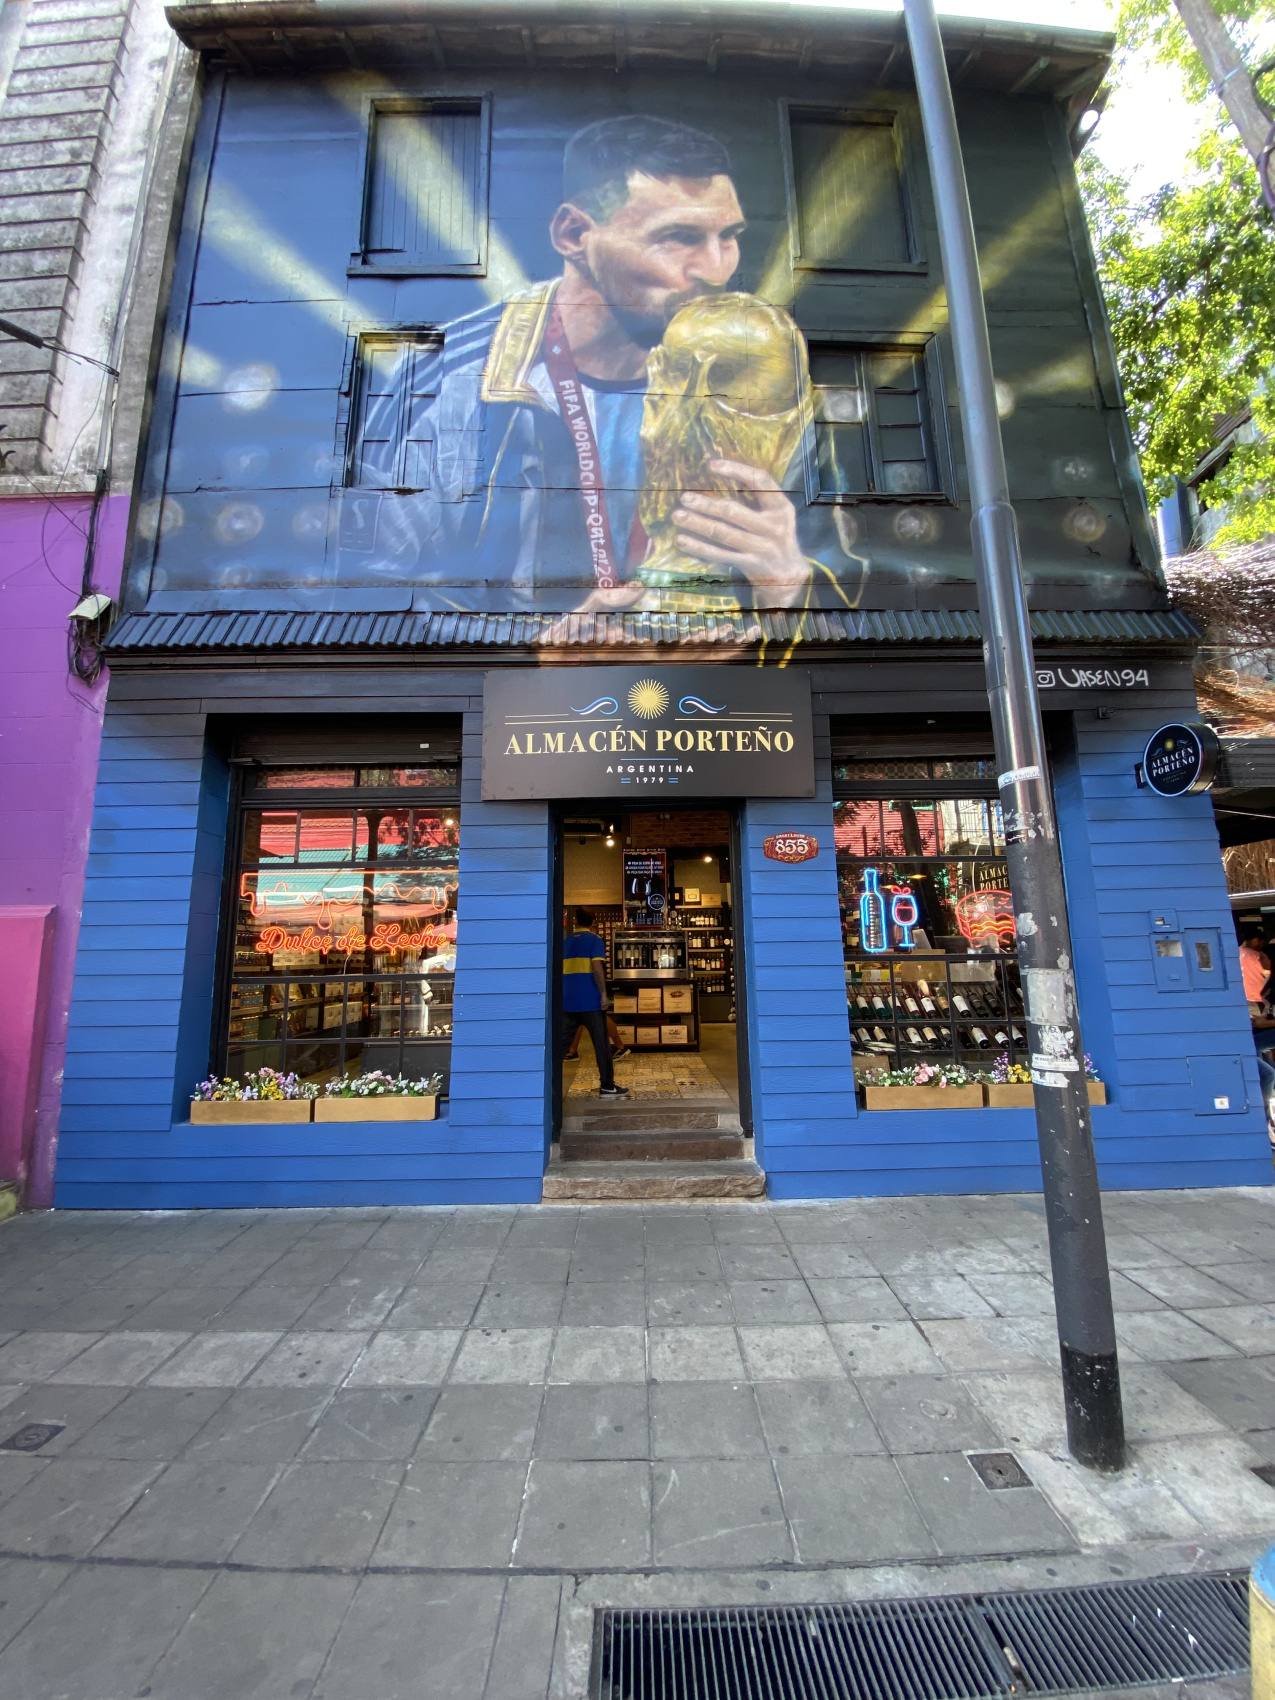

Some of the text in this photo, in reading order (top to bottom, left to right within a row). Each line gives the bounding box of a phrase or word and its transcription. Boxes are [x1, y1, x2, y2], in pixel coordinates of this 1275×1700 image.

[559, 380, 581, 415] FIFA
[503, 724, 794, 755] ALMACÉN PORTEÑO
[606, 765, 694, 773] ARGENTINA
[1151, 746, 1194, 769] ALMACÉN
[1152, 754, 1195, 777] PORTEÑO
[775, 839, 809, 854] 855
[979, 865, 1008, 882] ALMAC
[980, 877, 1009, 891] PORTE
[256, 923, 448, 956] Dulce de Leche
